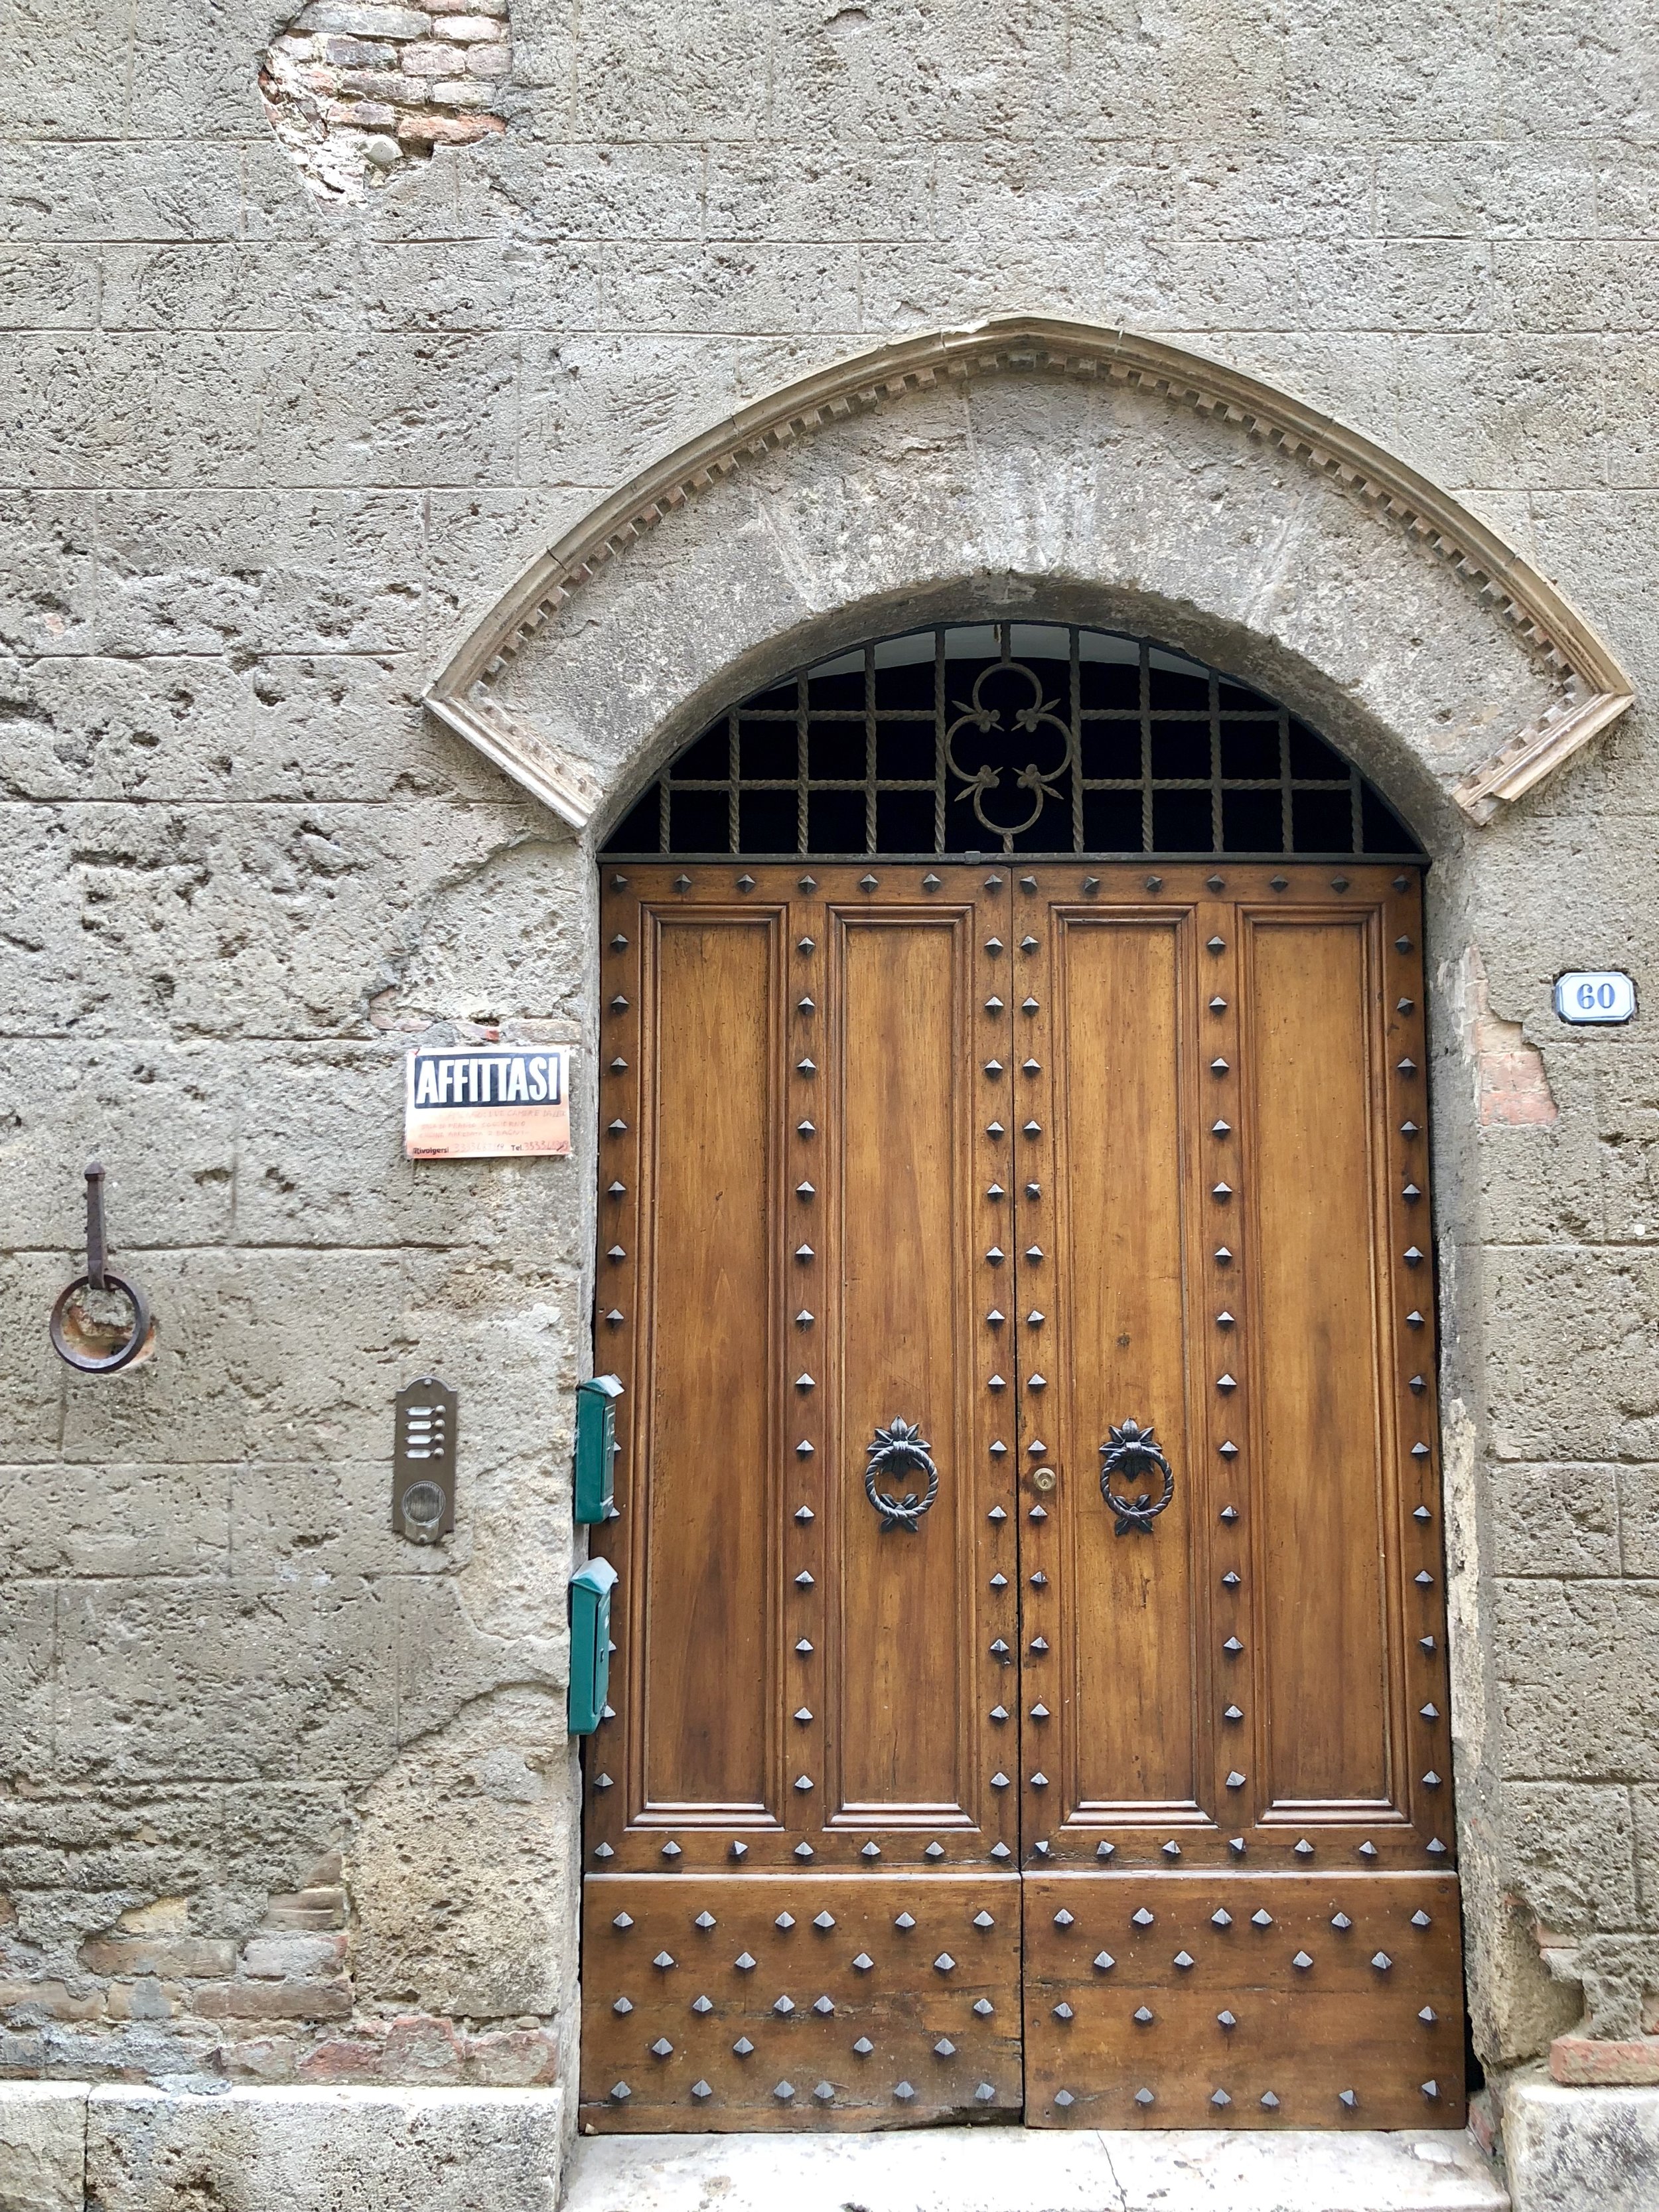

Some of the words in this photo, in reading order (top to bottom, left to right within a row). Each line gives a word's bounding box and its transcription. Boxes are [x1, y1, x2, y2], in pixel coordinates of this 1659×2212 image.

[1577, 983, 1615, 1009] 60
[416, 1057, 558, 1104] AFFITTASI
[413, 1146, 449, 1155] Rivolgersi
